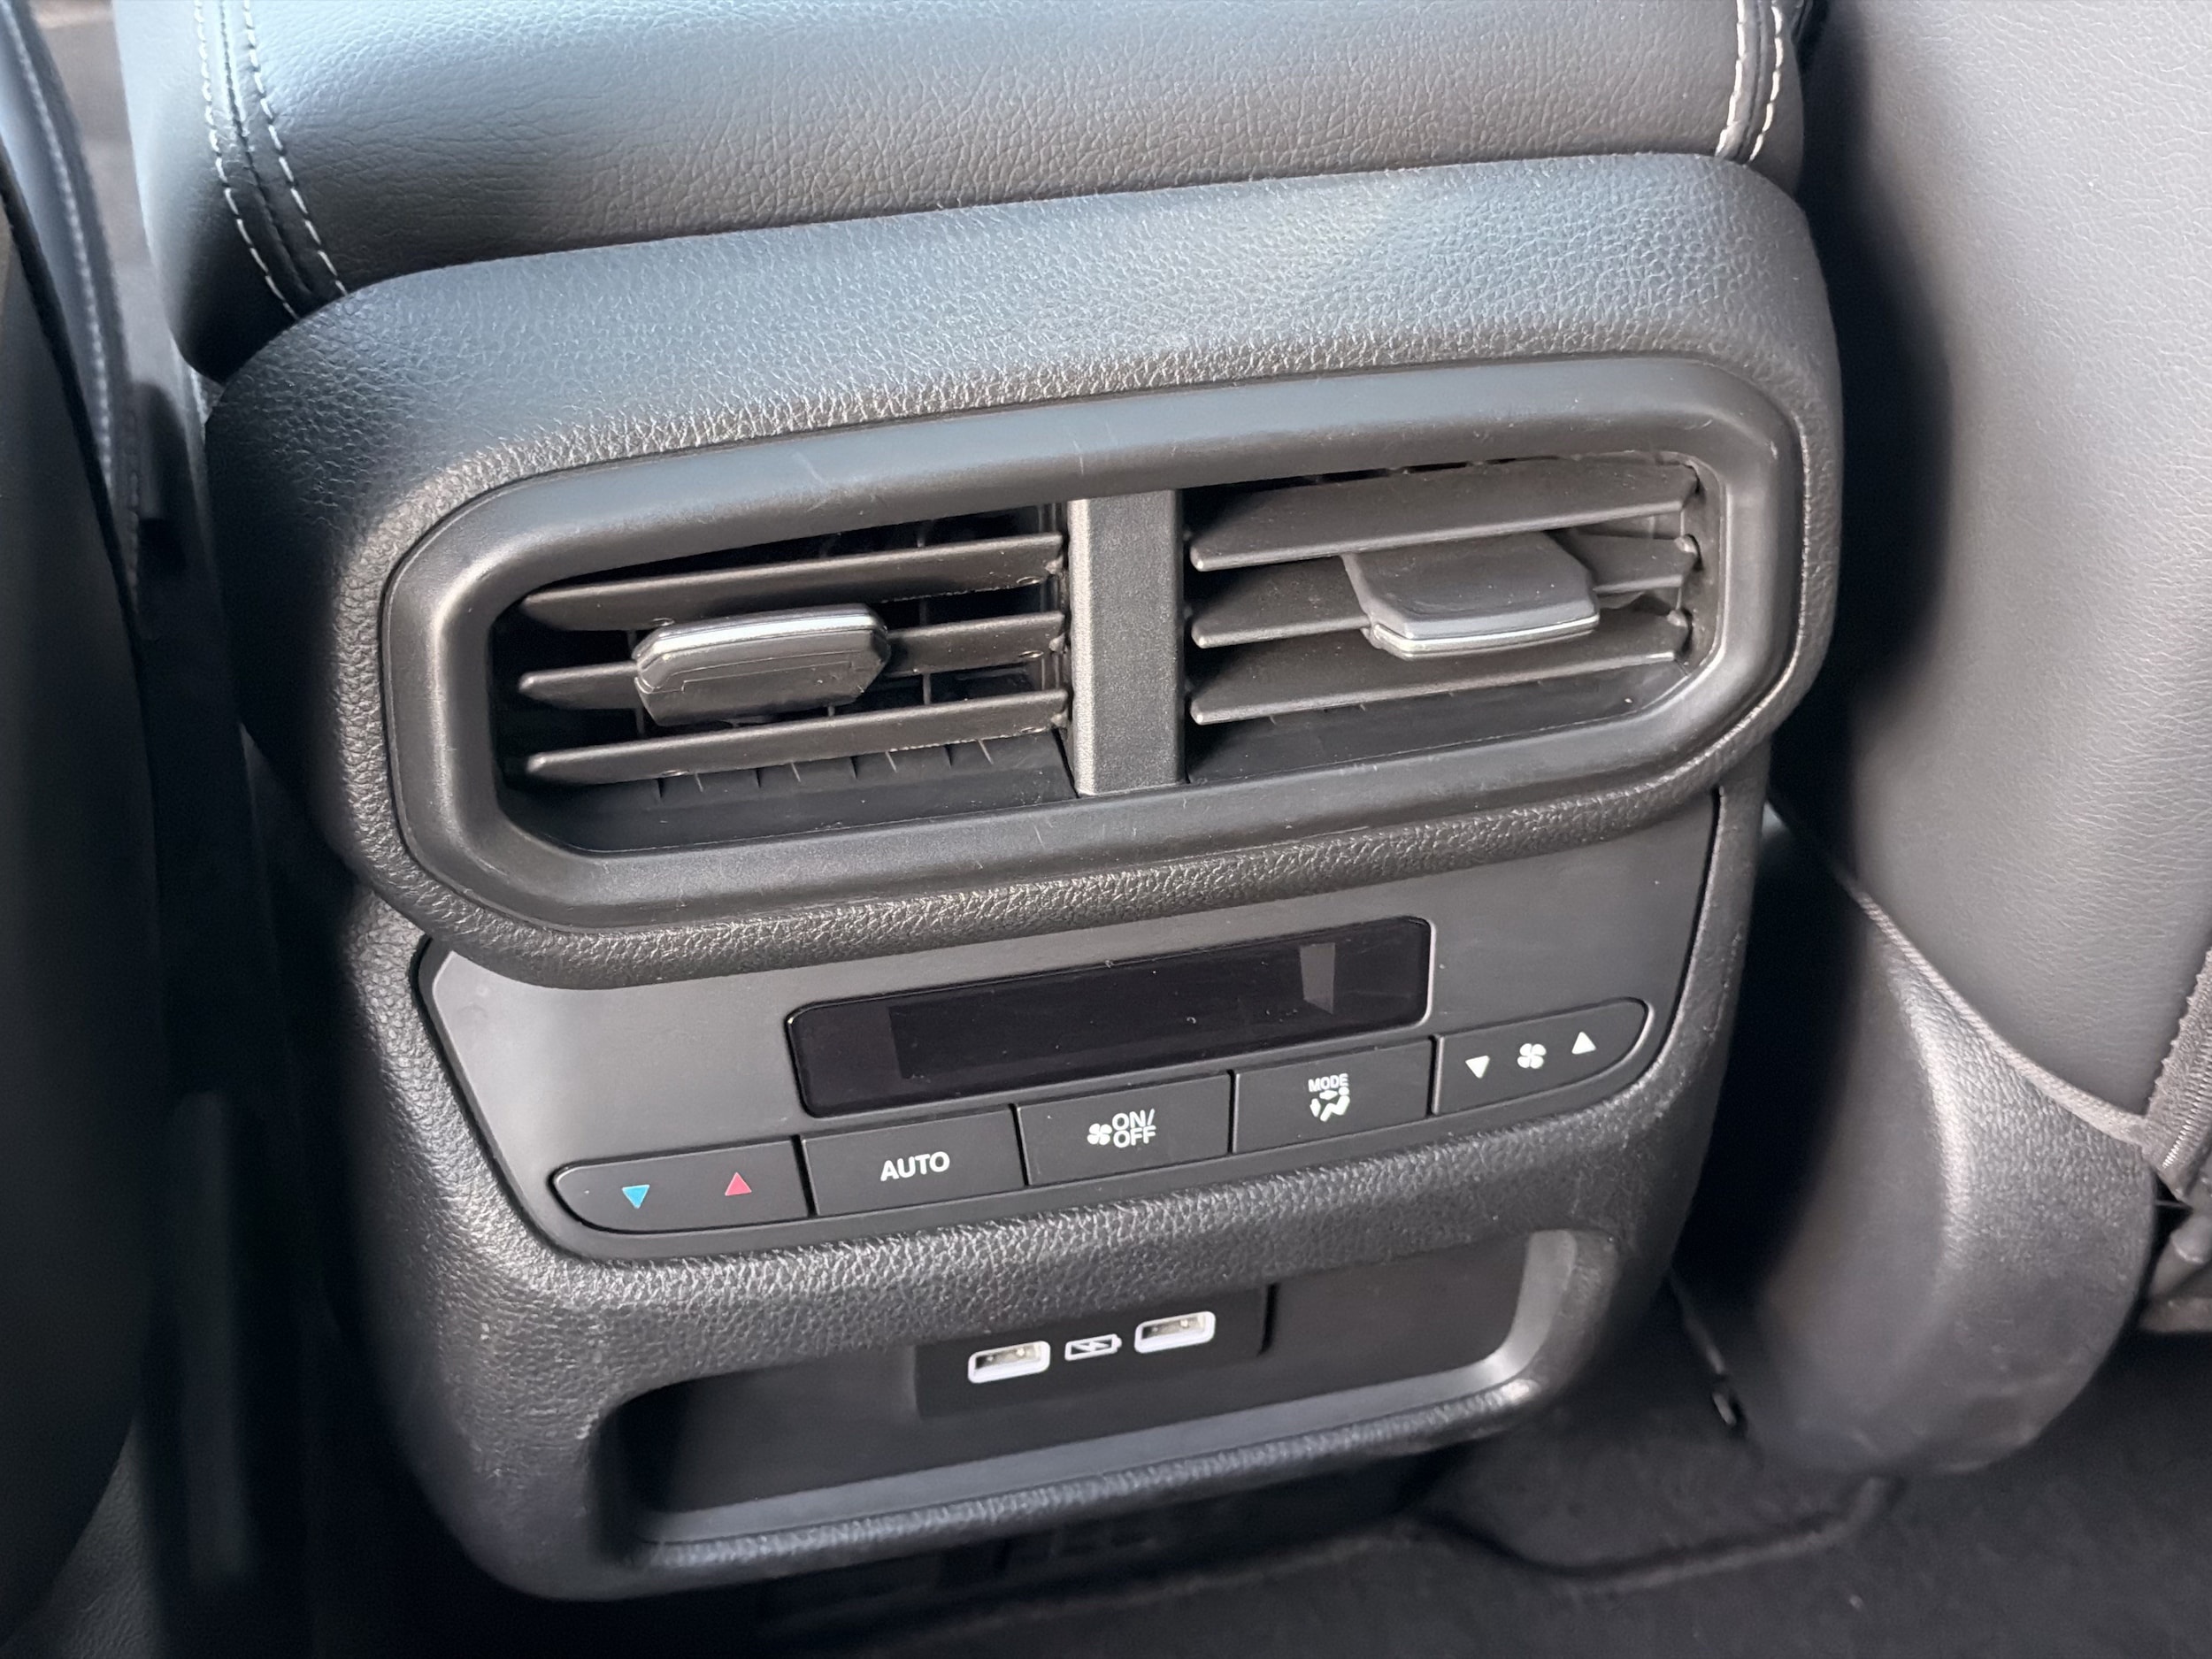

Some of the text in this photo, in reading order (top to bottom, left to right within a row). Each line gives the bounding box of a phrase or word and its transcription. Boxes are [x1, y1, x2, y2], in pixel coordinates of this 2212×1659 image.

[1308, 1072, 1348, 1093] MODE
[1111, 1108, 1156, 1130] ON/
[1112, 1124, 1157, 1148] OFF
[879, 1151, 950, 1181] AUTO
